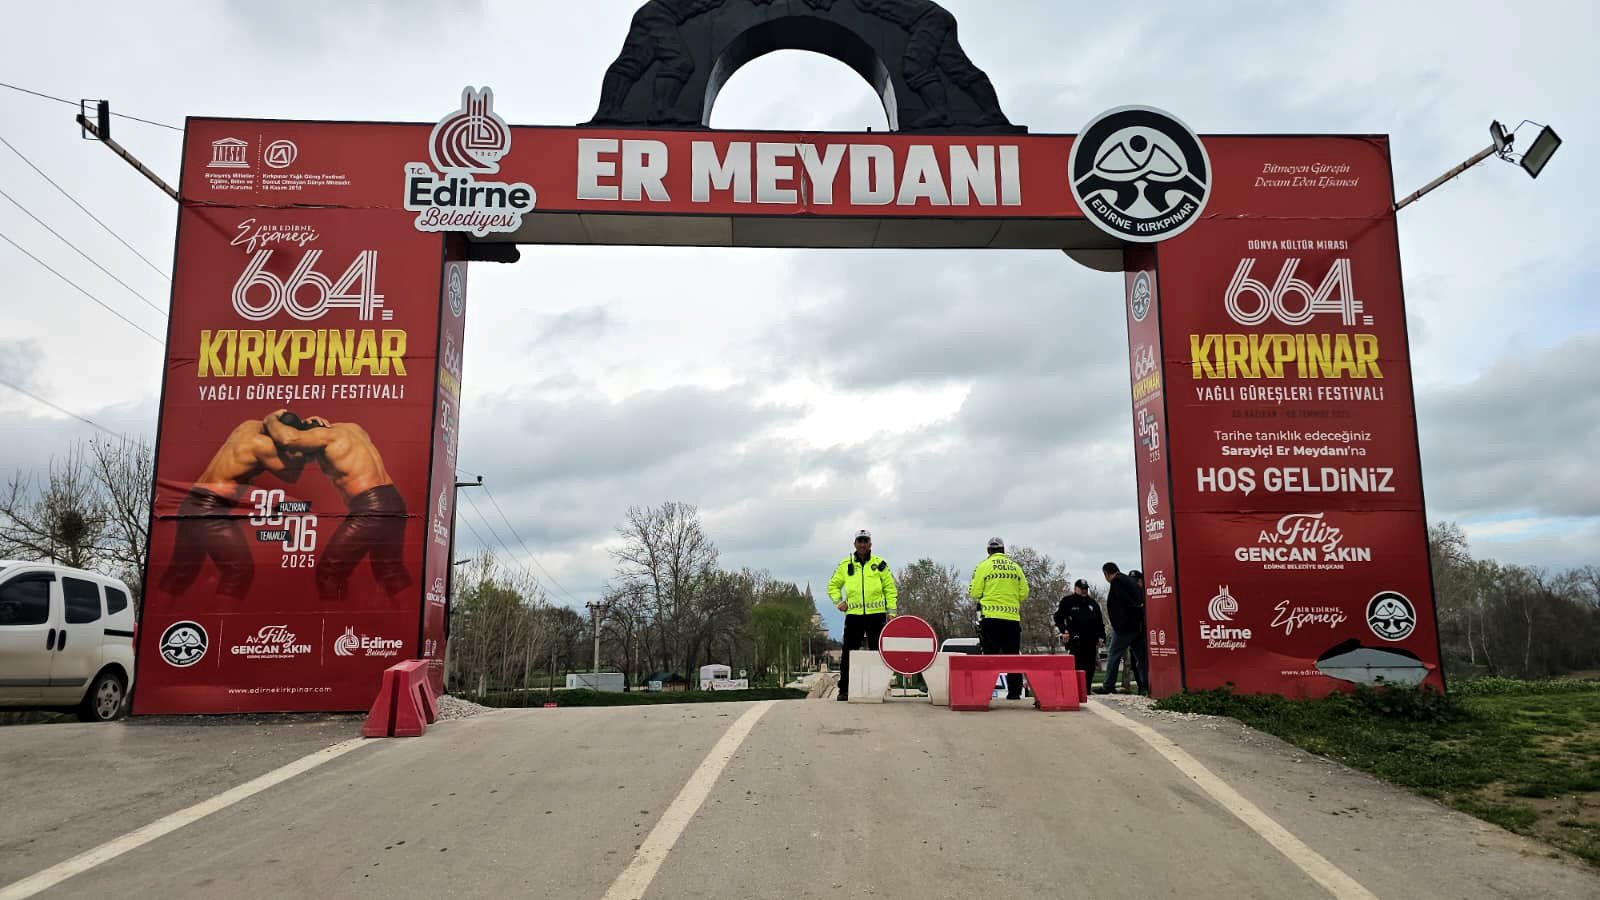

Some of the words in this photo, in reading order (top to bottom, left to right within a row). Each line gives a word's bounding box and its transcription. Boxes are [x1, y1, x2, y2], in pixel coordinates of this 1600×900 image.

[577, 138, 671, 202] ER
[691, 140, 1022, 207] MEYDANI
[1262, 163, 1309, 175] Bitmeyen
[1311, 162, 1350, 174] Güreşin
[410, 177, 531, 209] Edirne
[1254, 177, 1290, 187] Devam
[1291, 177, 1316, 187] Eden
[1318, 176, 1360, 188] Efsanesi
[420, 207, 517, 231] Belediyesi
[1091, 198, 1132, 230] EDİRNE
[1137, 202, 1195, 232] KIRKPINAR
[1247, 239, 1278, 250] DÜNYA
[1280, 239, 1313, 250] KÜLTÜR
[1316, 239, 1348, 250] MİRASI
[231, 249, 394, 321] 664.
[1224, 258, 1374, 326] 664.
[197, 329, 407, 377] KIRKPINAR
[1189, 333, 1384, 379] KIRKPINAR
[199, 384, 240, 401] YAĞLI
[246, 383, 326, 404] GÜREŞLERİ
[331, 384, 404, 401] FESTİVALİ
[1196, 385, 1235, 401] YAĞLI
[1240, 384, 1313, 405] GÜREŞLERİ
[1318, 385, 1384, 401] FESTİVALİ
[1213, 430, 1253, 441] Tarihe
[1255, 430, 1301, 441] tanıklık
[1304, 430, 1372, 443] edeceğiniz
[1222, 445, 1273, 458] Sarayiçi
[1276, 446, 1290, 456] Er
[1293, 445, 1367, 458] Meydanı'na
[1196, 467, 1256, 496] HOŞ
[1263, 467, 1396, 493] GELDİNİZ
[249, 489, 285, 526] 30
[282, 515, 318, 552] 06
[1258, 531, 1282, 544] Av.
[1277, 512, 1344, 552] Filiz
[281, 554, 316, 568] 2025
[1234, 548, 1317, 562] GENCAN
[1324, 548, 1372, 562] AKIN
[246, 635, 260, 644] Av.
[258, 624, 297, 649] Filiz
[361, 636, 403, 649] Edirne
[1200, 624, 1252, 639] Edirne
[231, 645, 279, 655] GENCAN
[282, 645, 311, 655] AKIN
[228, 686, 332, 695] www.edirnekirkpinar.com
